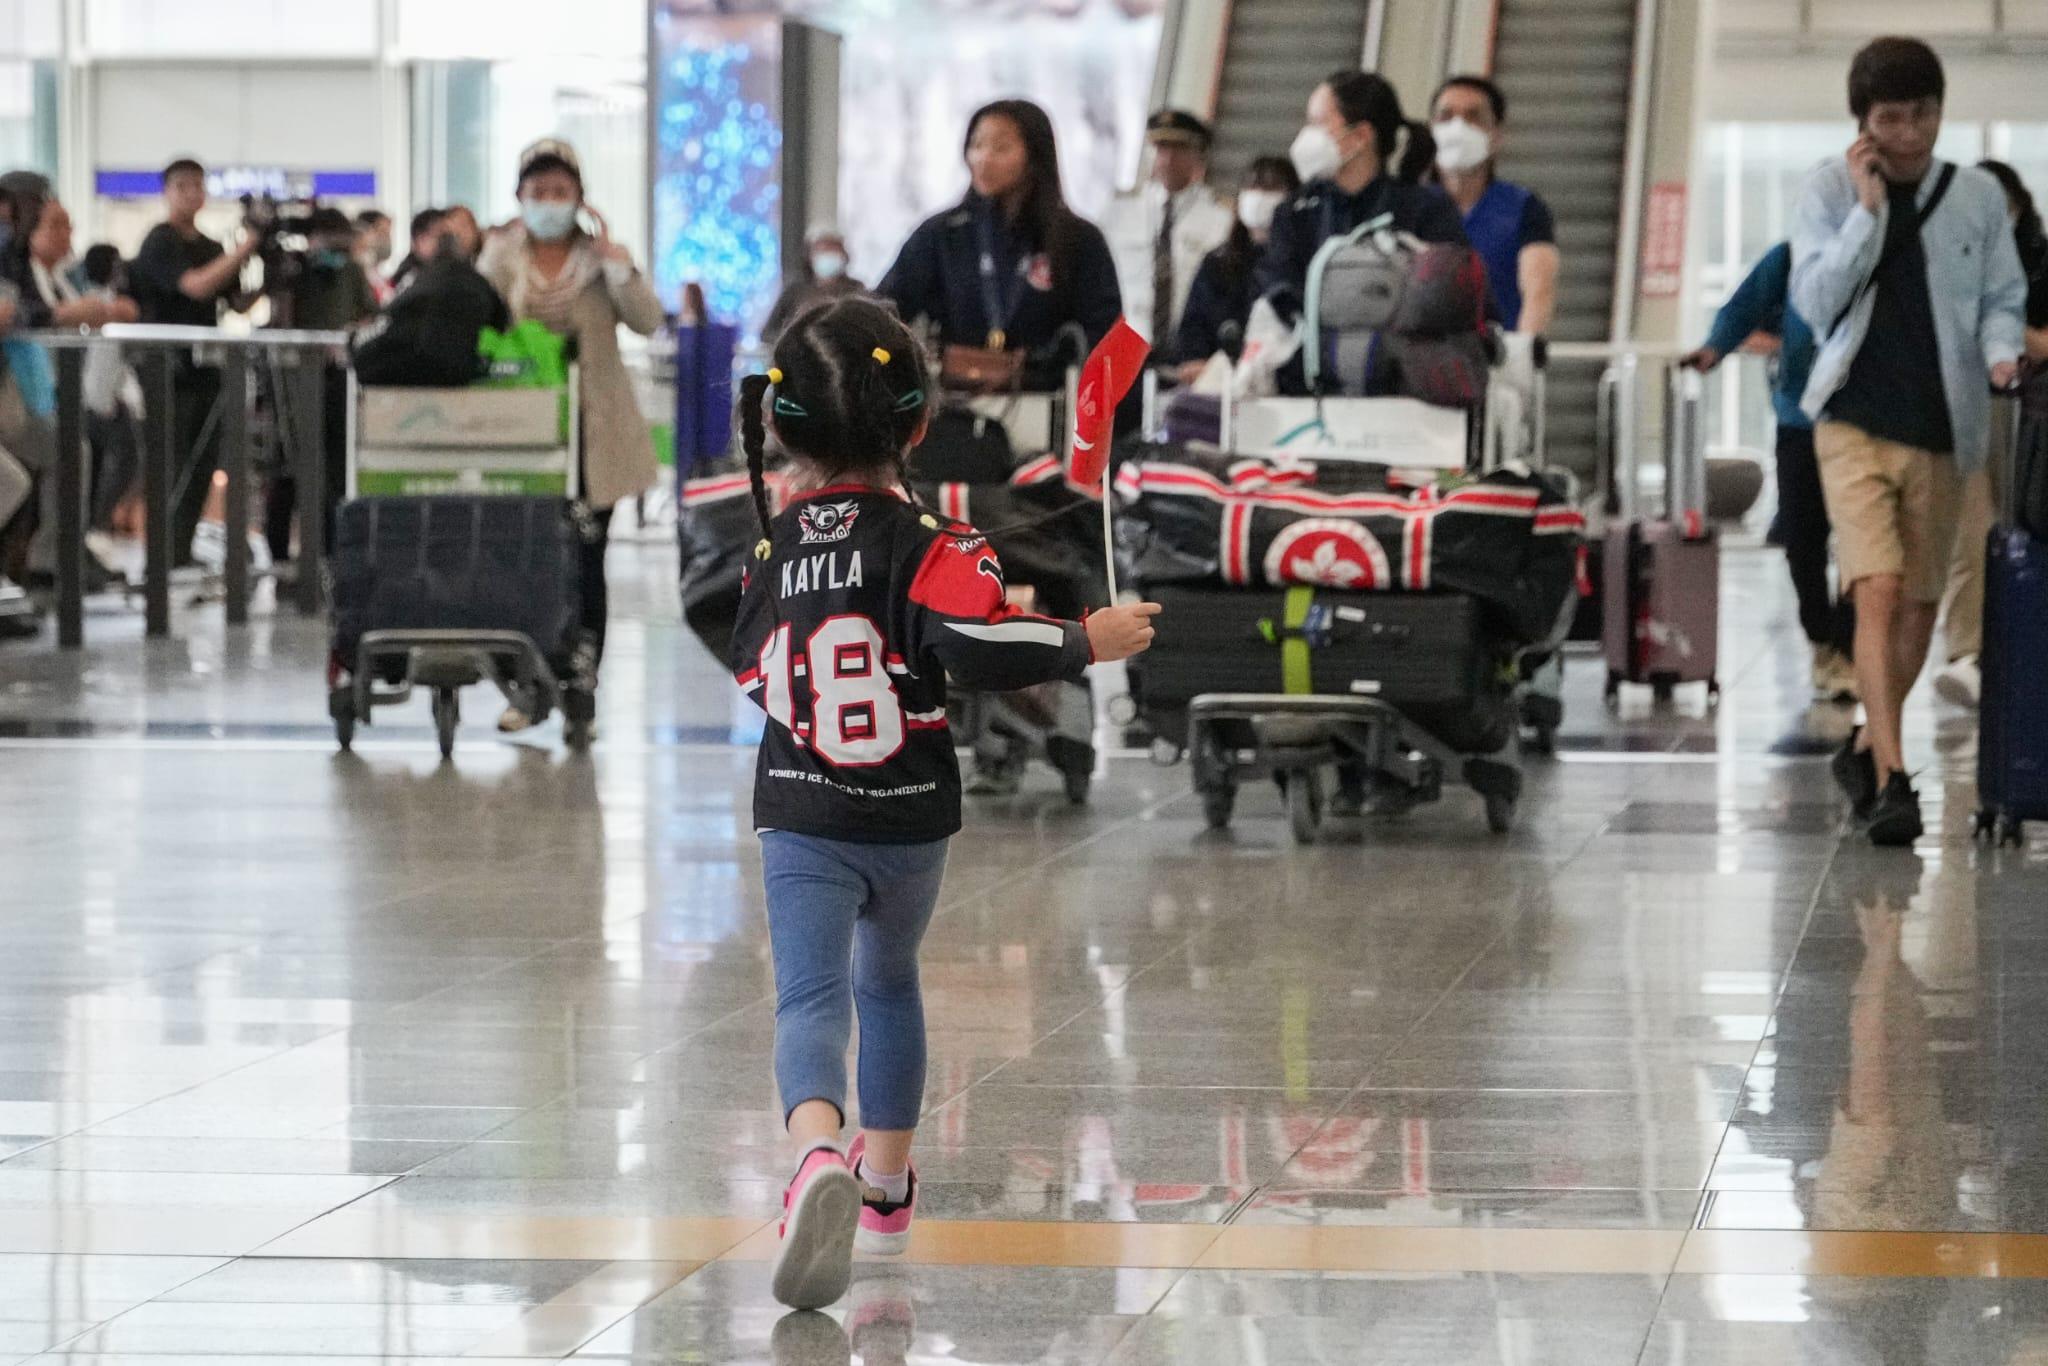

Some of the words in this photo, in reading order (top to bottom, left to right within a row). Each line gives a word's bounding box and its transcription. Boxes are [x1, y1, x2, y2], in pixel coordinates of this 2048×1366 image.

[780, 550, 863, 600] KAYLA
[759, 615, 906, 766] 18
[768, 768, 805, 780] WOMEN'S
[807, 772, 823, 784] ICE
